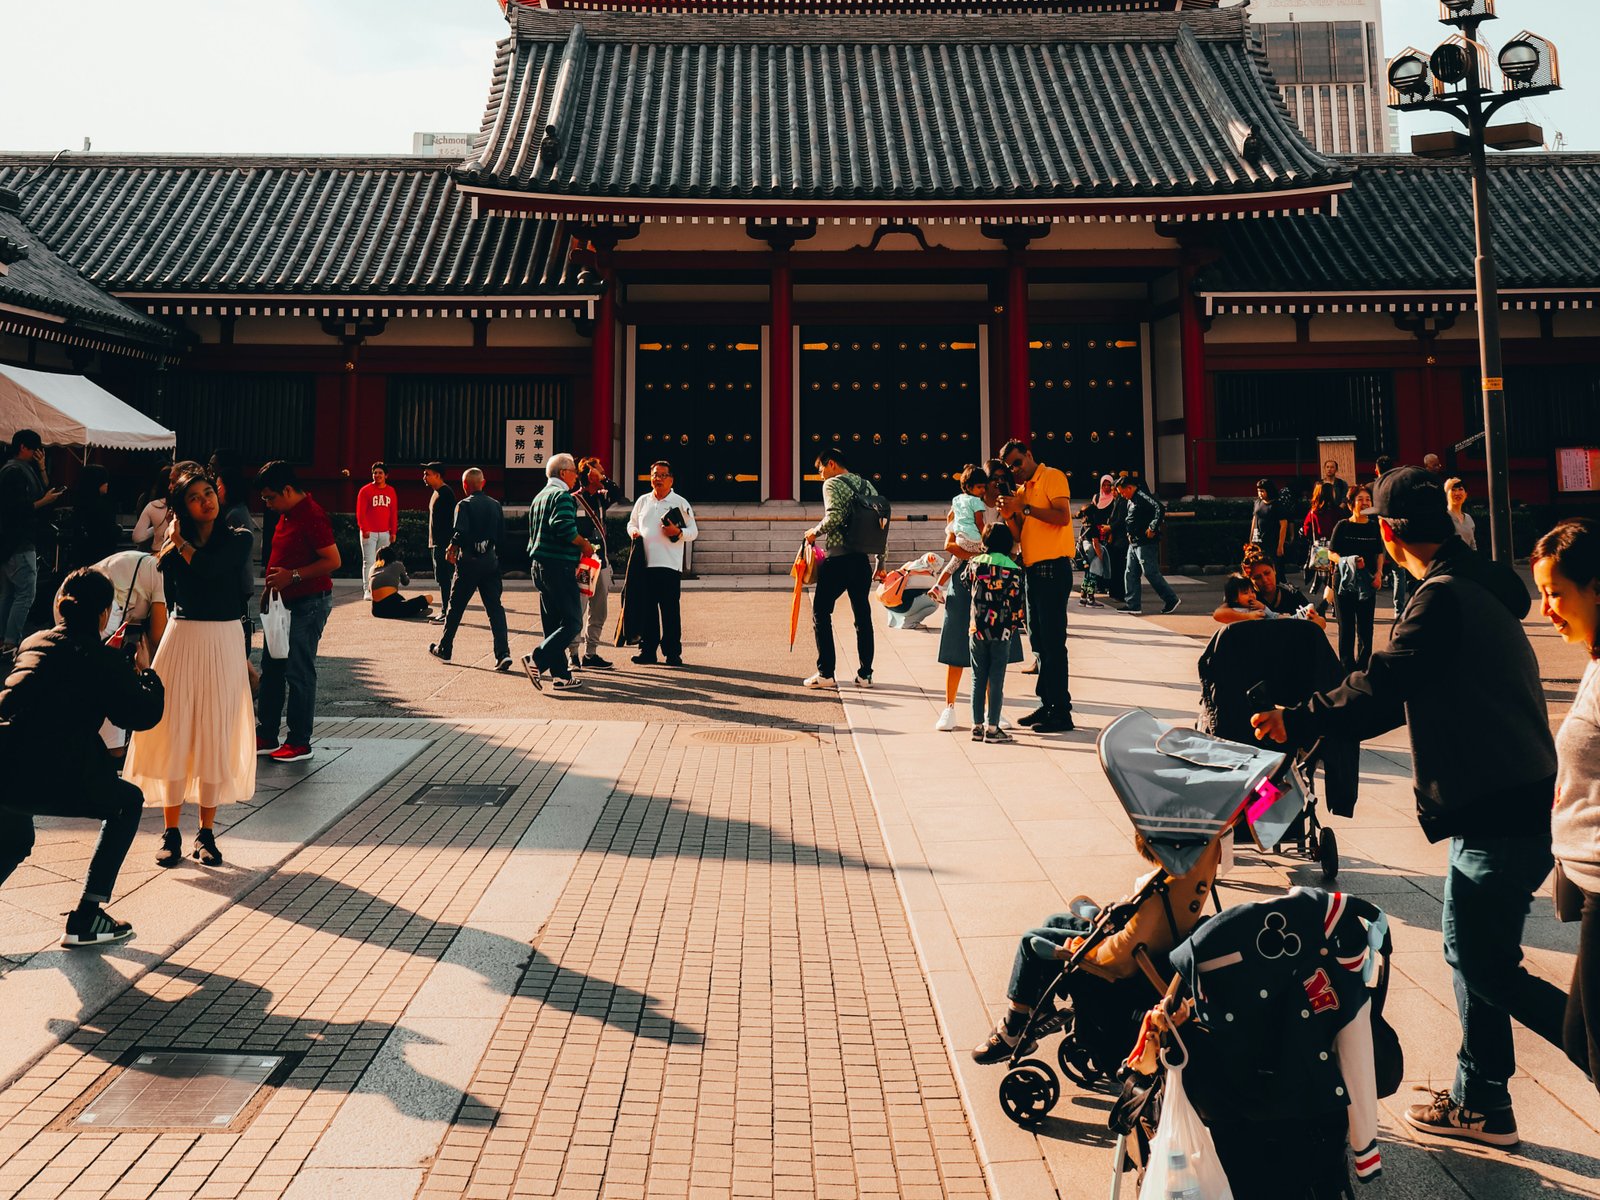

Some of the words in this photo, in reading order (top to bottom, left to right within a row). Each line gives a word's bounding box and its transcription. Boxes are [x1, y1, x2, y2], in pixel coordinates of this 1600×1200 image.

[432, 134, 467, 144] Richmon
[514, 424, 525, 464] 寺務所
[533, 424, 544, 464] 浅草寺
[372, 495, 392, 508] GAP
